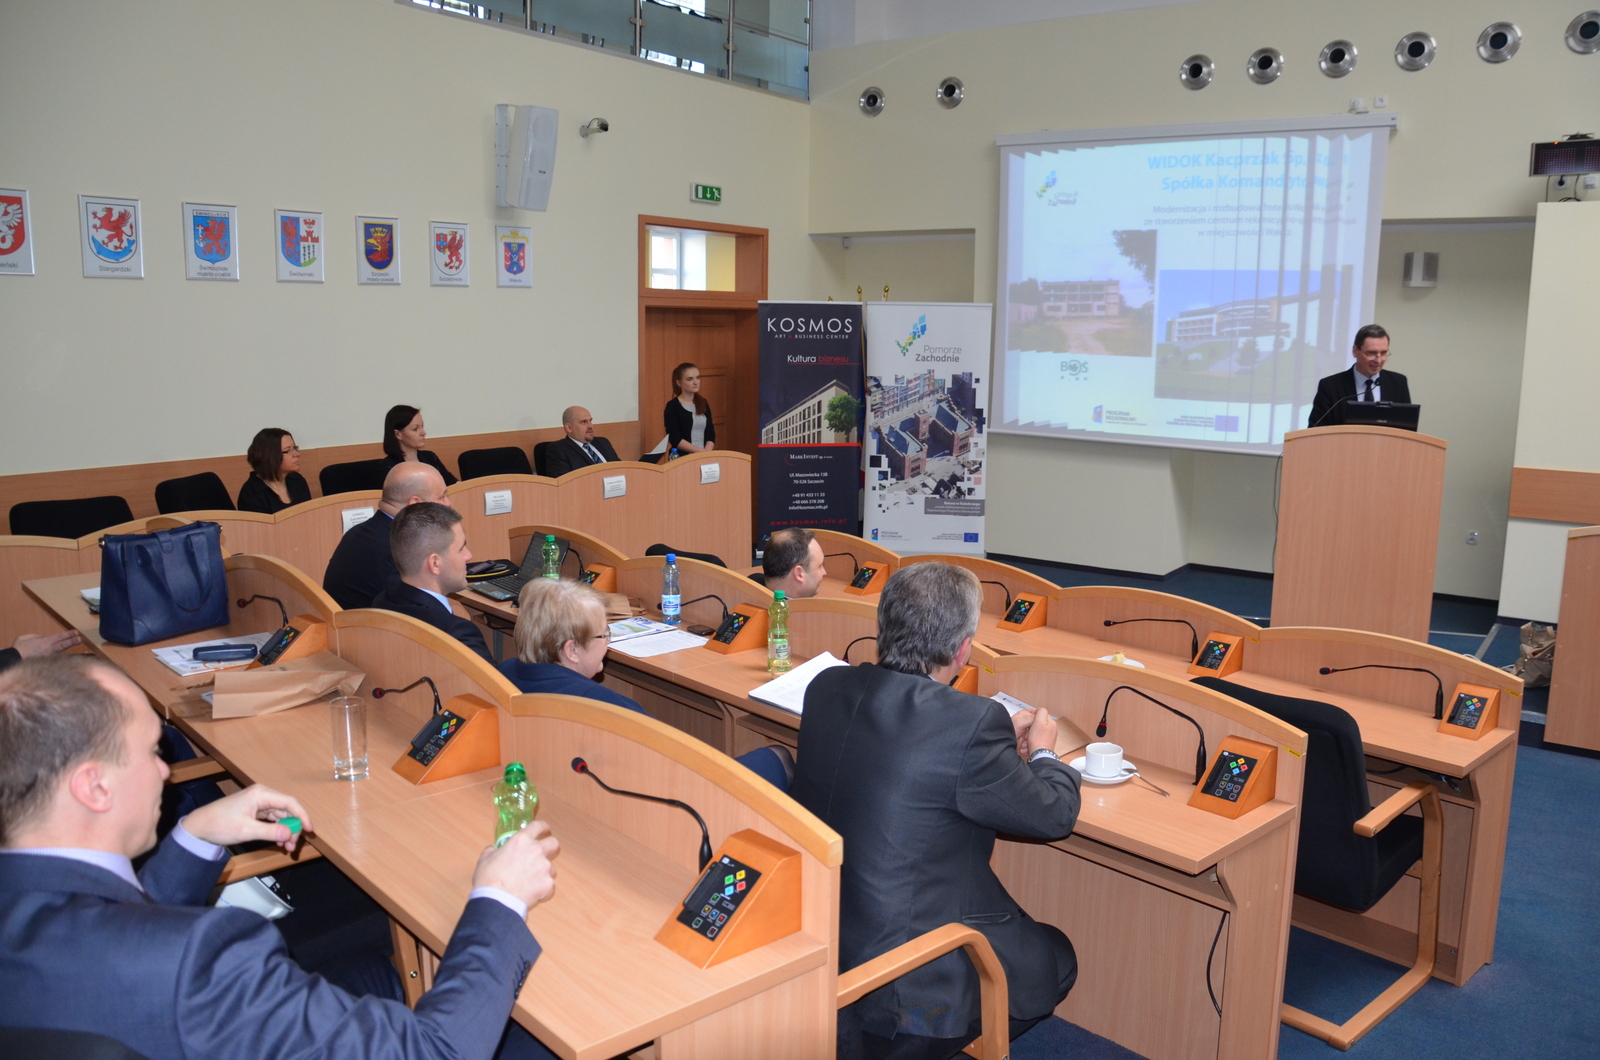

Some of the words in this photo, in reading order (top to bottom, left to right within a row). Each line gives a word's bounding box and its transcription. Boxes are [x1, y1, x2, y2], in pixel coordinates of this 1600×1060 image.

[1148, 154, 1202, 169] WIDOK
[1206, 151, 1279, 170] Kacprzak
[1162, 176, 1214, 193] Spółka
[1152, 204, 1206, 214] Modernizacja
[1213, 204, 1261, 212] rozbudowa
[768, 318, 852, 332] KOSMOS
[924, 344, 962, 354] Pomorze
[787, 354, 816, 362] Kultura
[916, 354, 960, 362] Zachodnie
